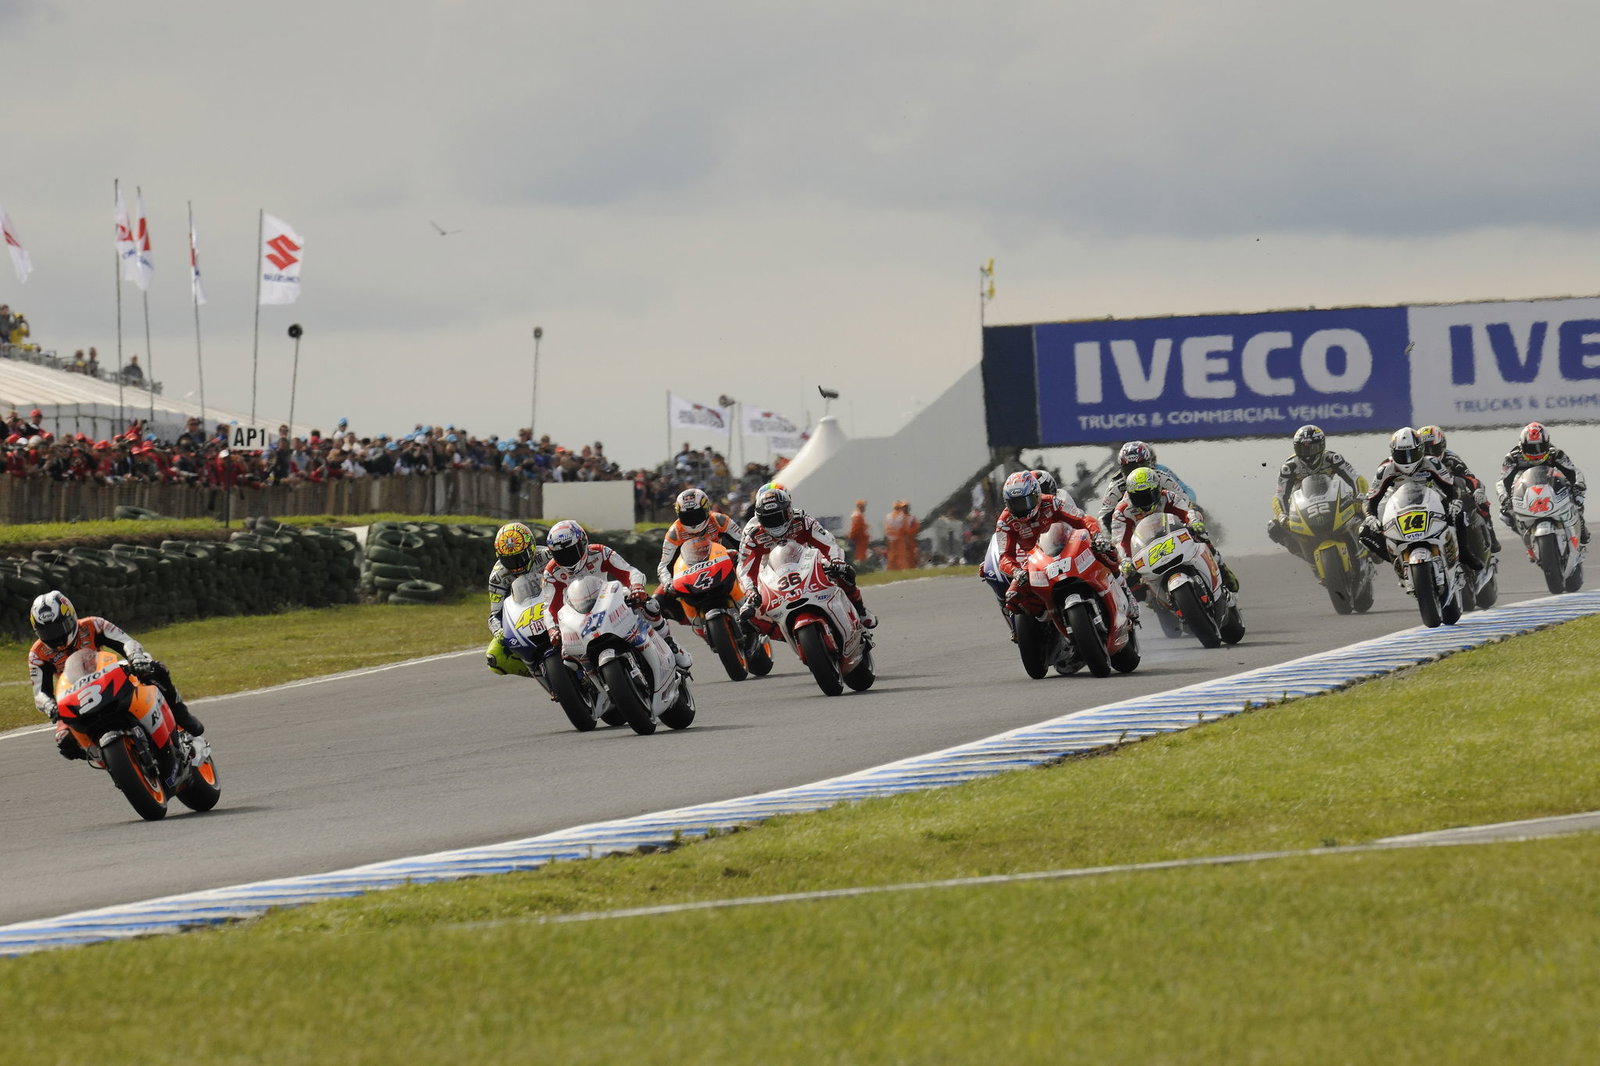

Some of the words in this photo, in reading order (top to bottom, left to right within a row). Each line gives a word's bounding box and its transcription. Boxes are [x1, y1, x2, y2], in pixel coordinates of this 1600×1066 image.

[1074, 328, 1373, 403] IVECO
[1449, 319, 1600, 385] IVE
[1078, 413, 1147, 430] TRUCKS
[1151, 412, 1163, 427] &
[1167, 406, 1286, 425] COMMERCIAL
[1288, 403, 1373, 421] VEHICLES
[1455, 396, 1522, 412] TRUCKS
[233, 427, 265, 447] AP1
[1307, 502, 1330, 518] 52
[1404, 515, 1424, 531] 14
[1149, 536, 1175, 567] 24
[693, 571, 714, 590] 4
[777, 572, 802, 591] 36
[514, 602, 546, 630] 46
[581, 610, 606, 638] 27
[77, 684, 103, 715] 3
